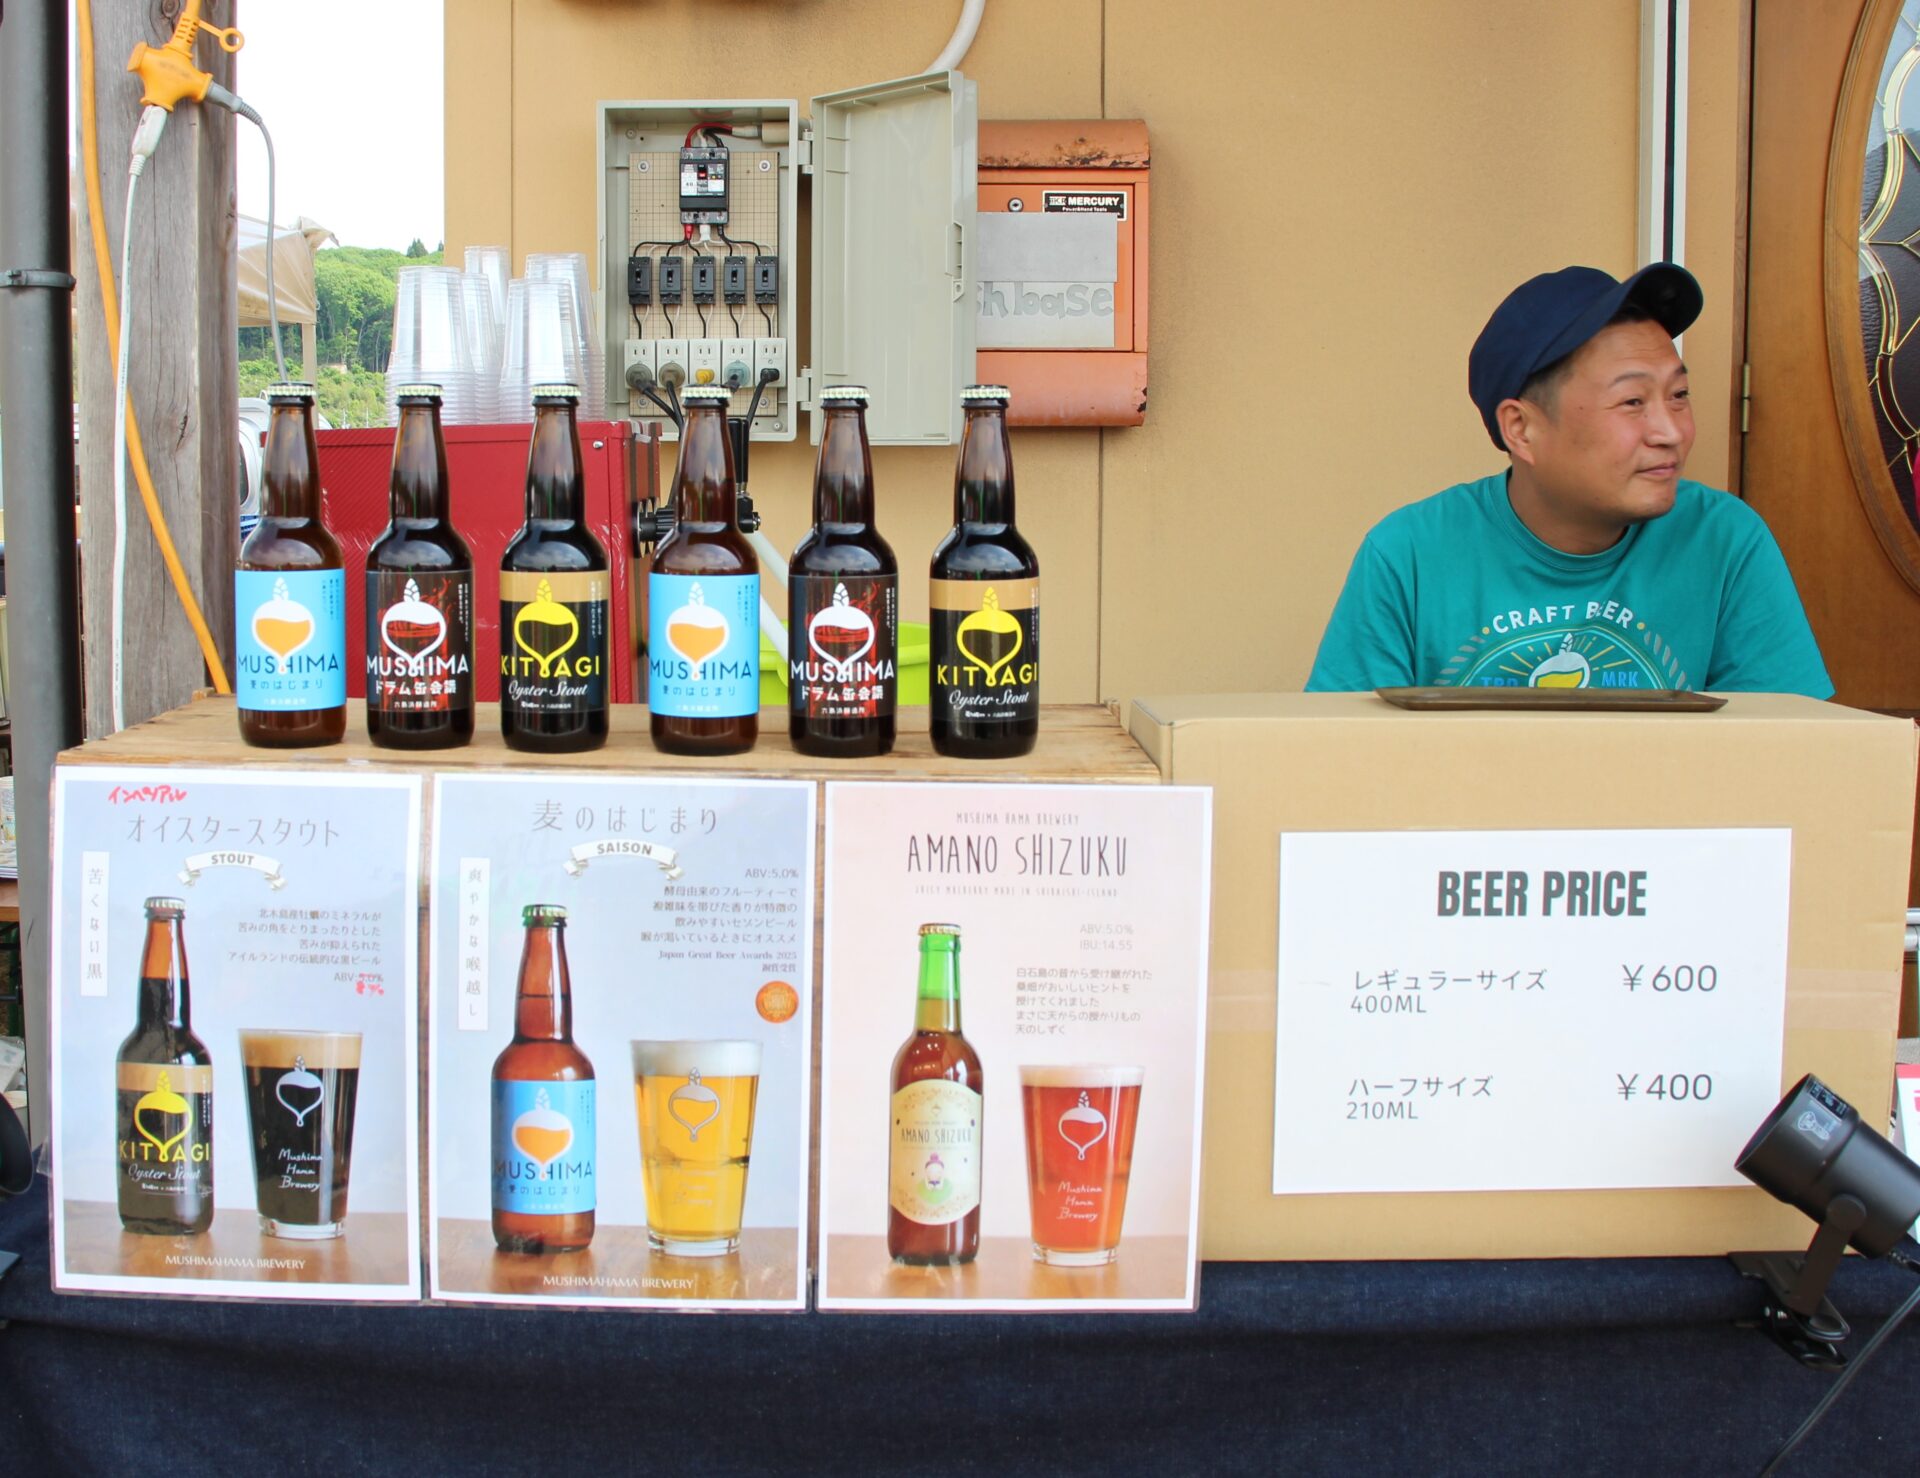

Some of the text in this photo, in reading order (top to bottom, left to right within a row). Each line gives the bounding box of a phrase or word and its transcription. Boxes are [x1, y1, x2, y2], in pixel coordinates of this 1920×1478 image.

[1068, 196, 1119, 206] MERCURY
[1492, 605, 1575, 633] CRAFT
[238, 653, 340, 674] MUSHIMA
[367, 653, 469, 676] MUSHIMA
[651, 659, 752, 681] MUSHIMA
[791, 659, 894, 682] MUSHIMA
[251, 679, 323, 691] 麦のはじまり
[1602, 671, 1638, 687] MRK
[508, 680, 588, 700] Oyster Stout
[662, 685, 736, 697] 麦のはじまり
[949, 689, 1029, 710] Oyster Stout
[532, 799, 717, 835] 麦のはじまり
[127, 814, 339, 847] オイスタースタウト
[597, 842, 652, 855] SAISON
[908, 833, 1126, 877] AMANO SHIZUKU
[211, 853, 254, 866] STOUT
[744, 868, 799, 879] ABV:5.0%
[1437, 870, 1648, 917] BEER PRICE
[87, 868, 103, 979] 苦くない黒
[658, 951, 685, 960] Japan
[741, 951, 773, 960] Awards
[1354, 968, 1548, 992] レギュラーサイズ
[1350, 995, 1428, 1014] 400ML
[1016, 1024, 1065, 1035] 天のしずく
[1348, 1075, 1494, 1098] ハーフサイズ
[1346, 1101, 1419, 1121] 210ML
[128, 1163, 167, 1181] Oyster
[278, 1175, 320, 1192] Brewery
[165, 1255, 306, 1269] MUSHIMAHAMA BREWERY
[543, 1276, 693, 1289] MUSHIMAHAMA BREWERY
